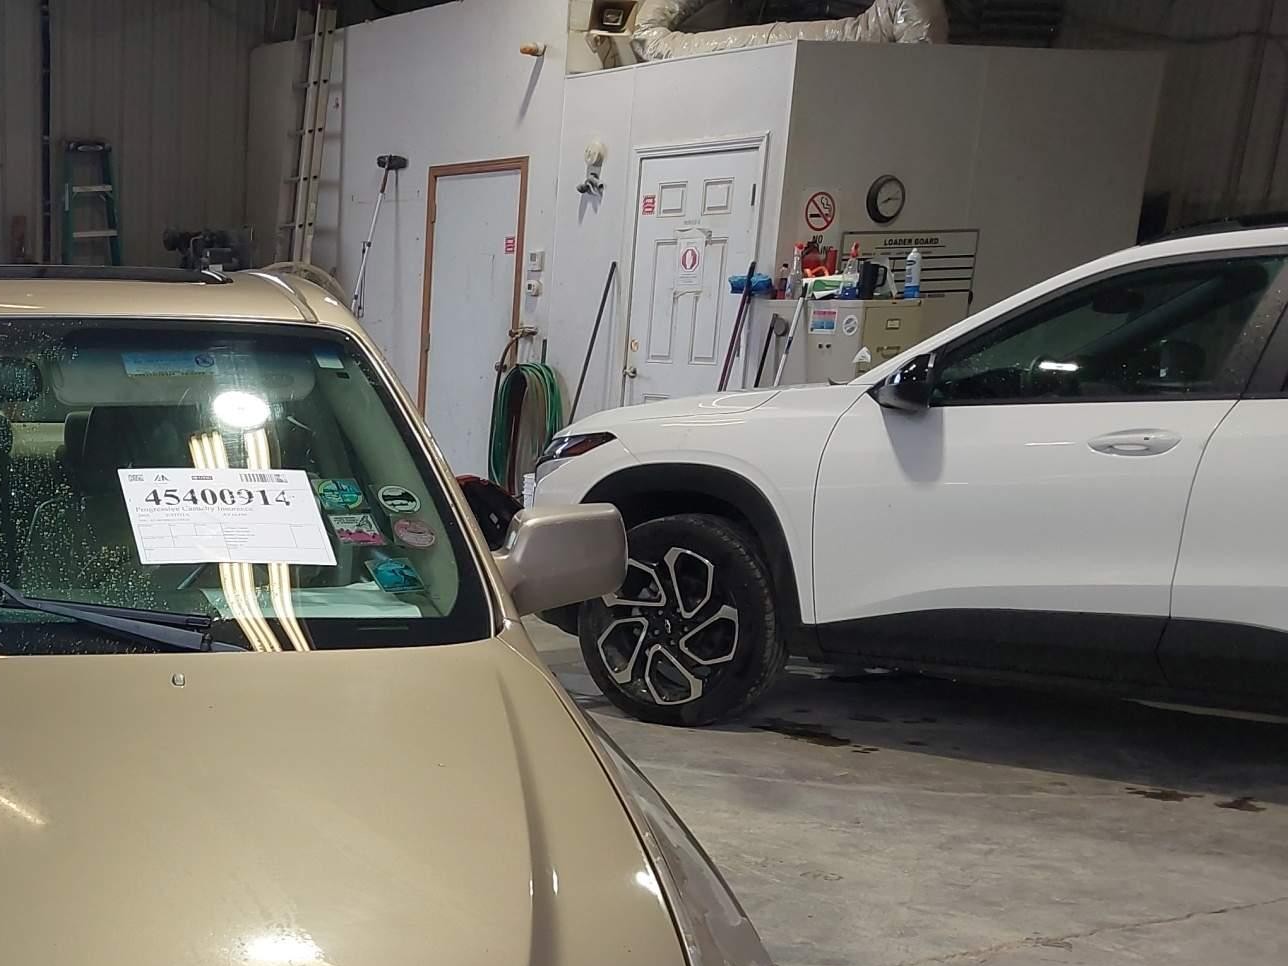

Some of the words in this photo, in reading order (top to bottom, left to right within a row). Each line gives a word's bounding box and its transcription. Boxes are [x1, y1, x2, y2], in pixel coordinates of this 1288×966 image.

[883, 237, 913, 246] LOADER
[914, 237, 940, 245] BOARD
[144, 488, 292, 507] 45400914
